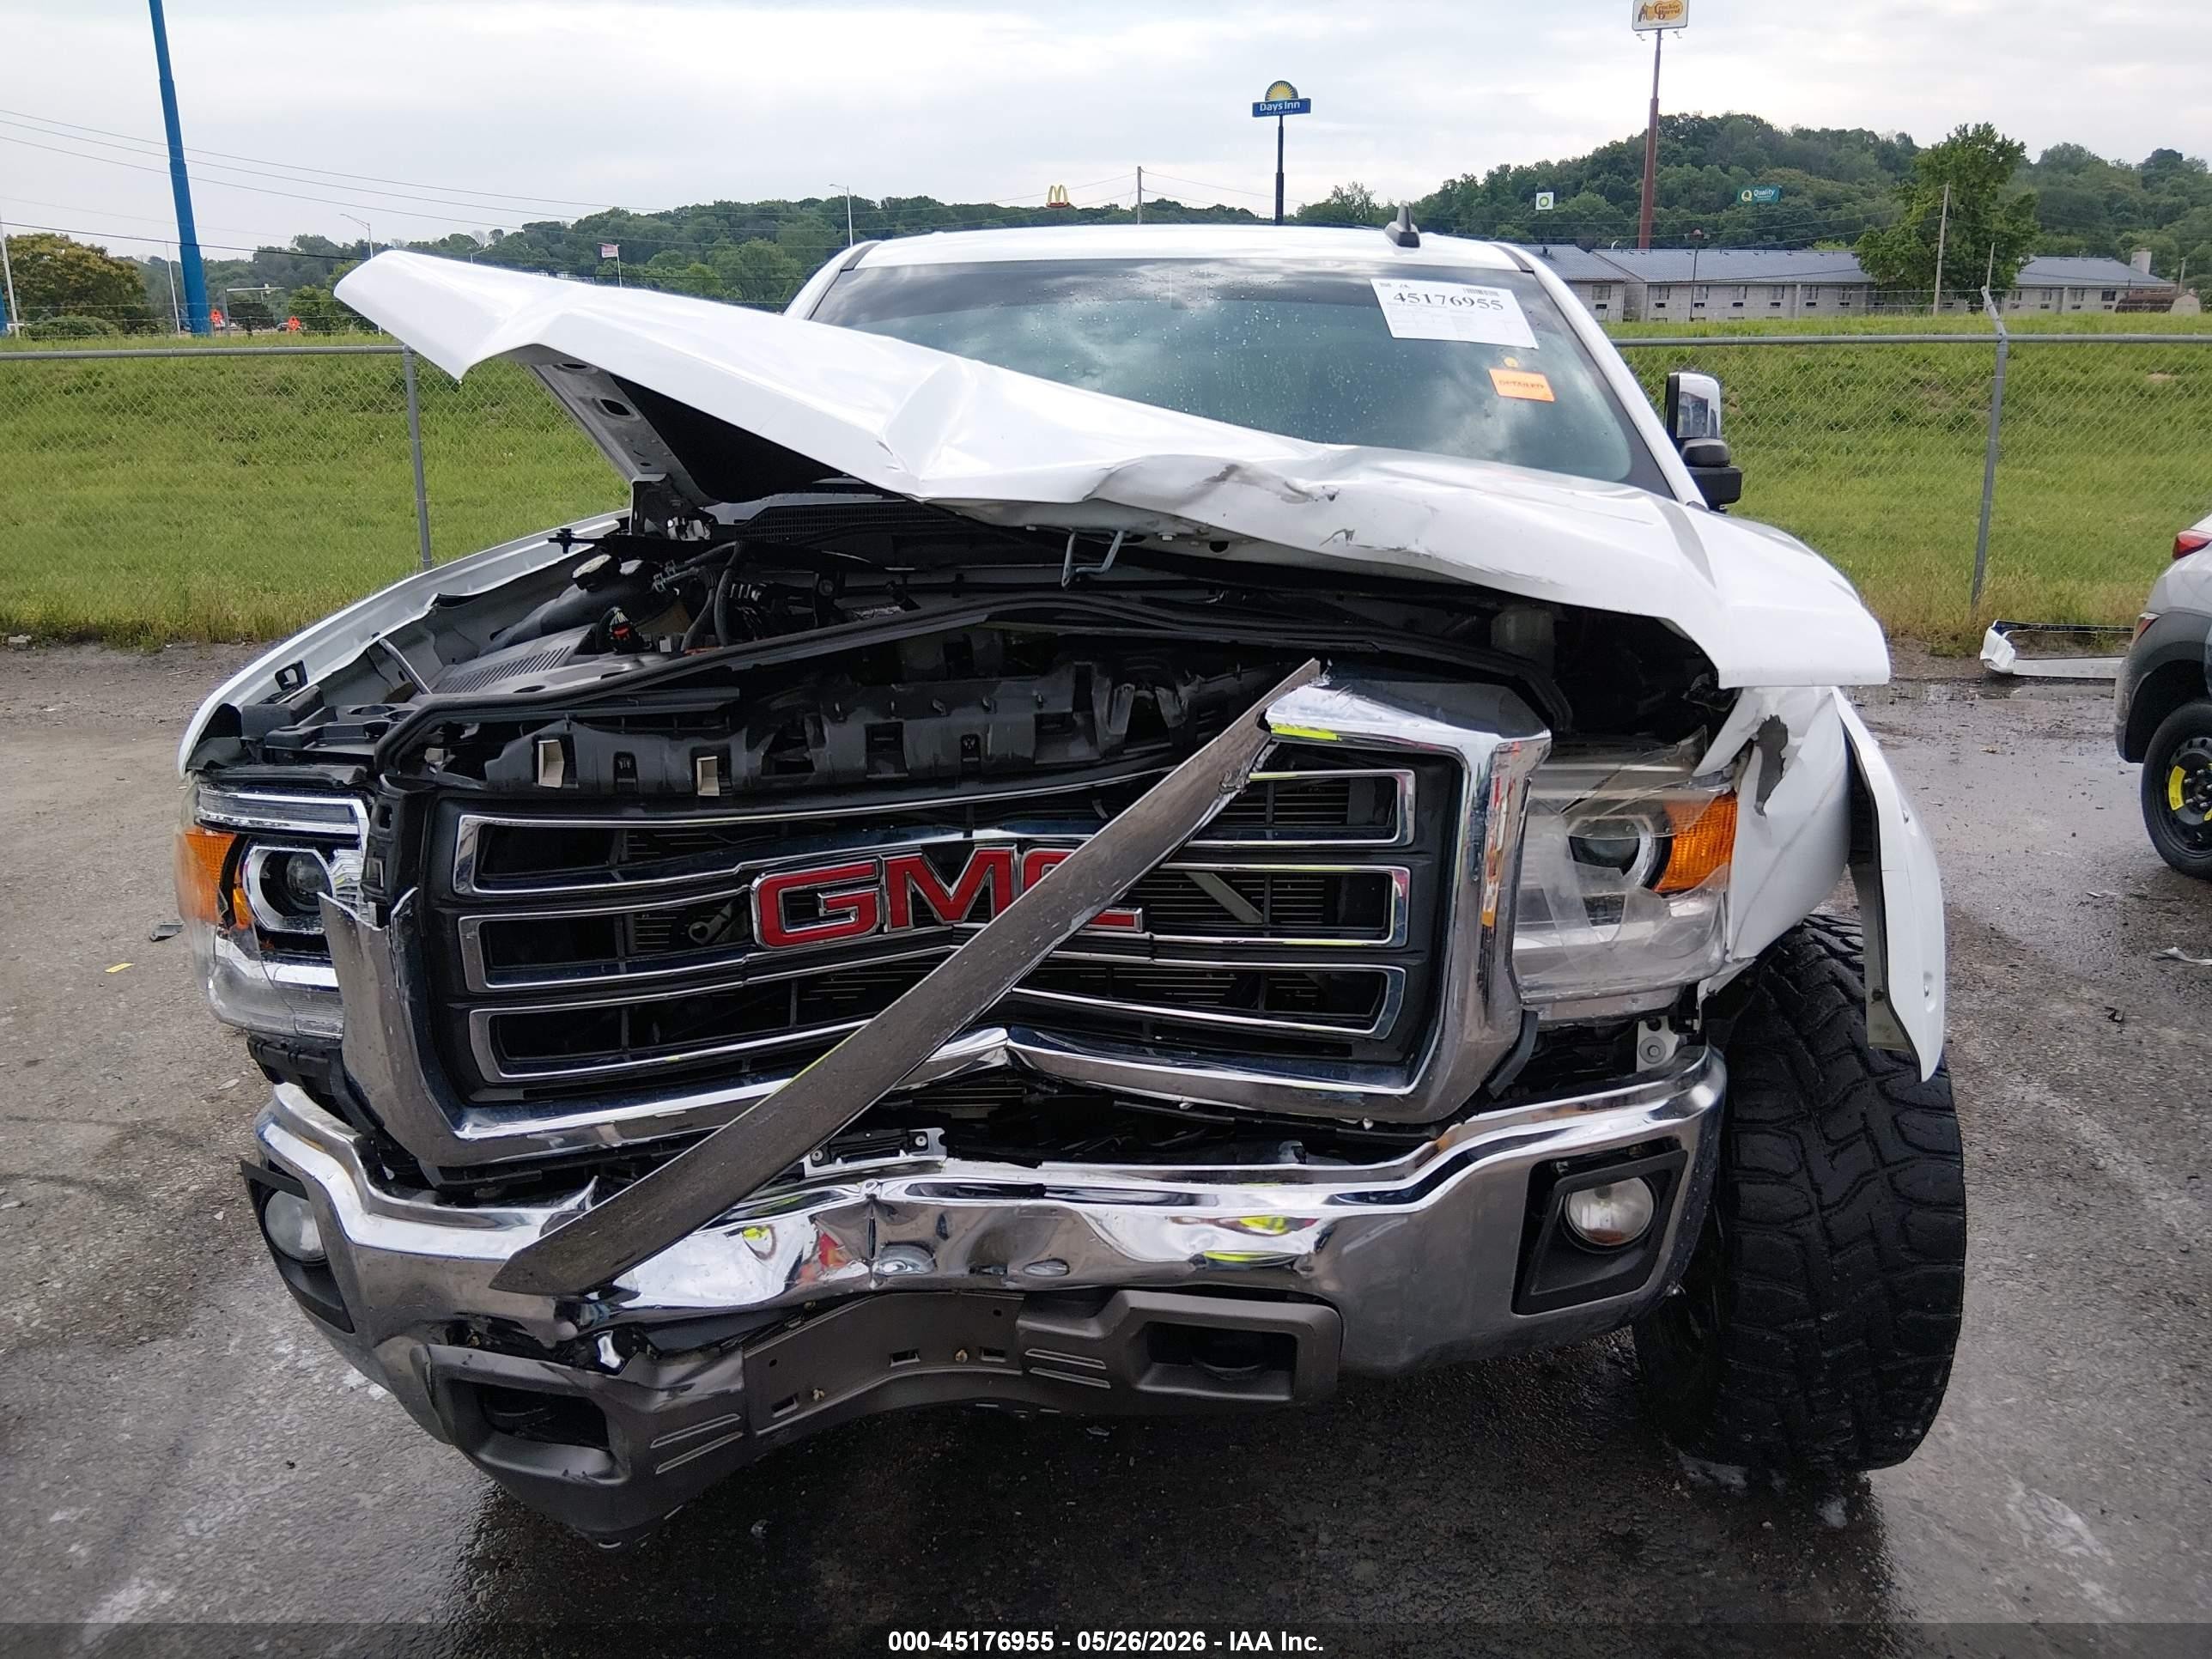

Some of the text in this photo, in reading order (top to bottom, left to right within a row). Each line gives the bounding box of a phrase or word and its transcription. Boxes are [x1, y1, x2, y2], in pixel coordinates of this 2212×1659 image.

[1260, 101, 1300, 112] Days Inn
[1394, 292, 1504, 311] 45176955
